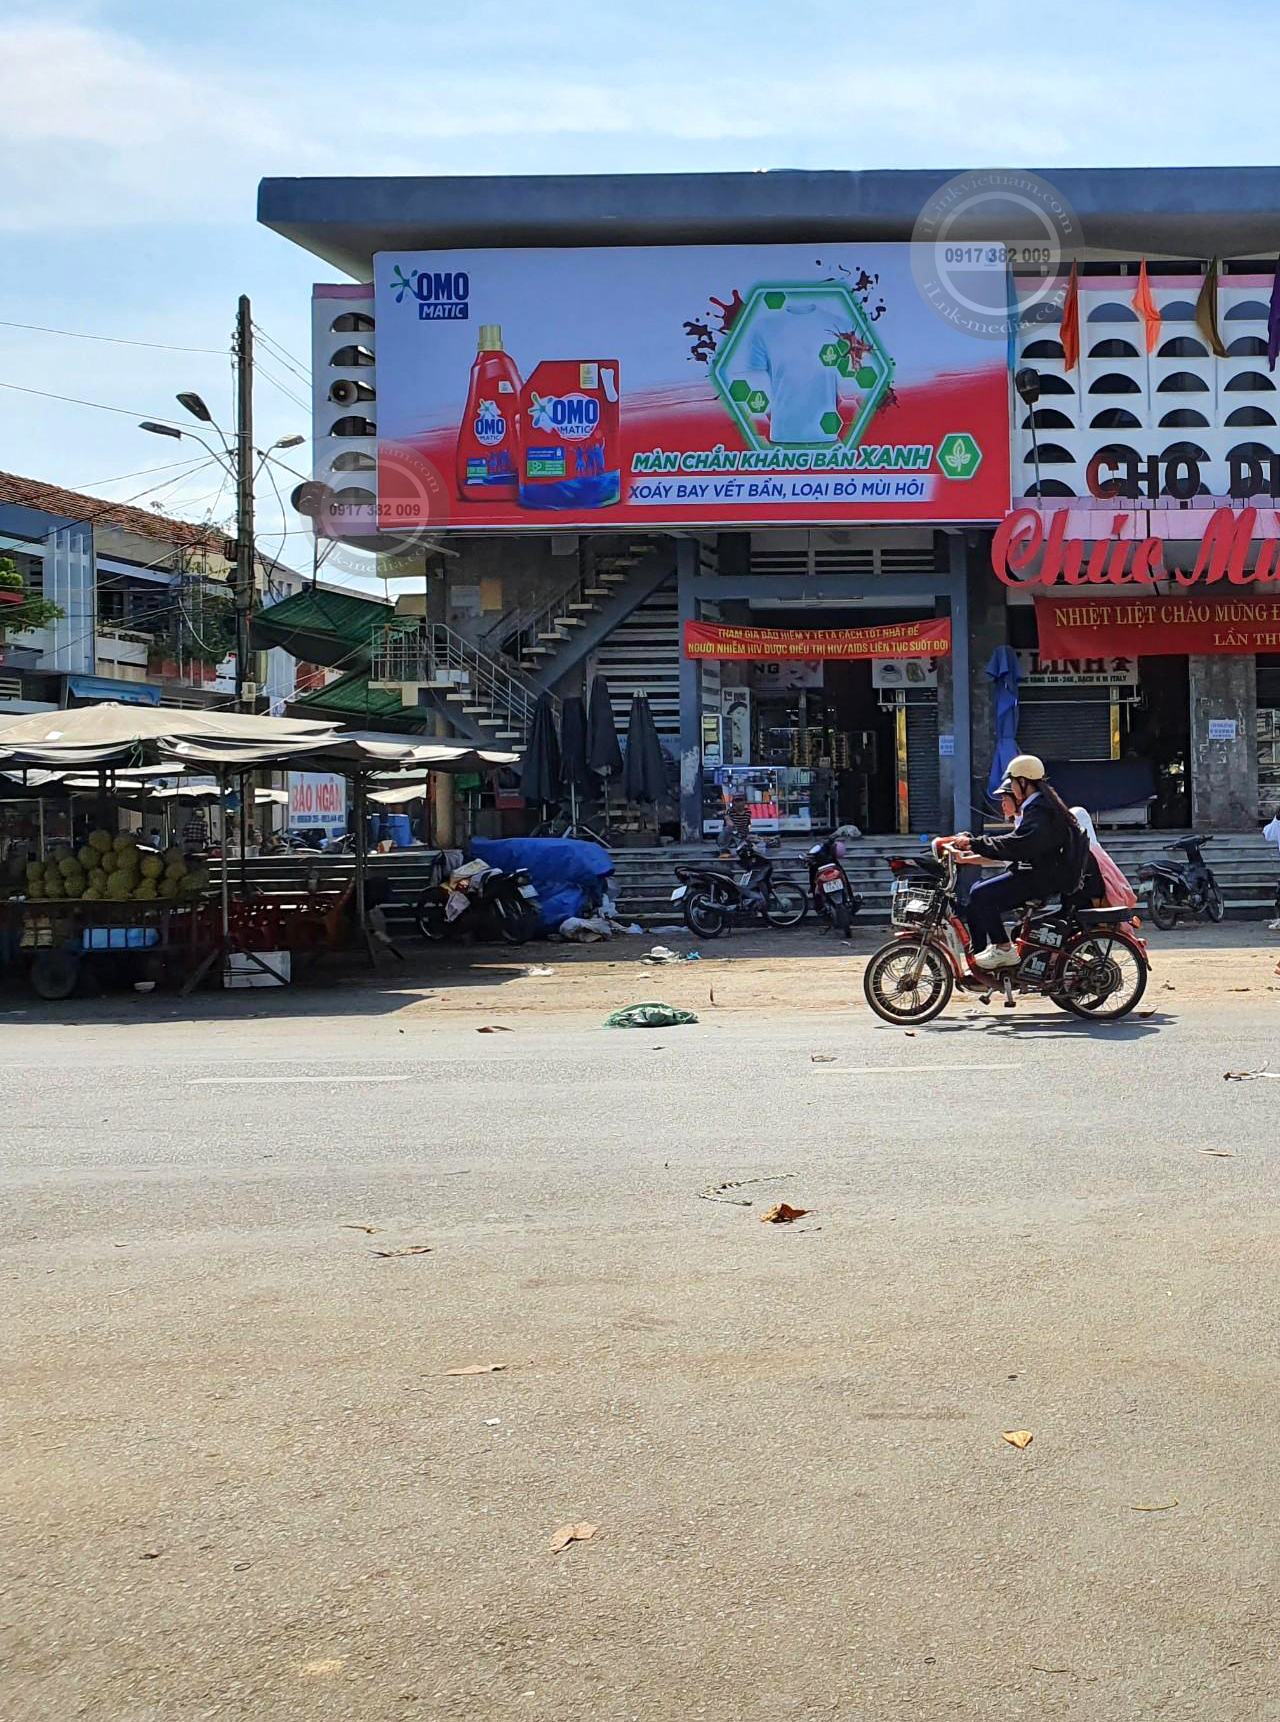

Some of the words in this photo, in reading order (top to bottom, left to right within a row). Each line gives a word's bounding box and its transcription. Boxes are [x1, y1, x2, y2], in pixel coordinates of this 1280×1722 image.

[417, 272, 469, 301] OMO
[422, 304, 465, 318] MATIC
[552, 400, 599, 425] OMO
[475, 418, 505, 435] OMO
[560, 426, 590, 435] MATIC
[633, 449, 681, 471] MÀN
[682, 445, 735, 471] CHẮN
[740, 449, 810, 470] KHÁNG
[814, 446, 857, 467] BẨN
[859, 446, 932, 468] XANH
[629, 481, 673, 499] XOÁY
[677, 483, 709, 498] BAY
[713, 479, 745, 497] VẾT
[749, 478, 787, 499] BẨN,
[791, 482, 829, 500] LOẠI
[833, 479, 857, 497] BỎ
[862, 480, 891, 496] MÙI
[895, 480, 924, 496] HÔI
[991, 507, 1168, 588] Chúc
[1053, 602, 1111, 630] NHIỆT
[1115, 601, 1156, 629] LIỆT
[1161, 600, 1209, 623] CHÀO
[1215, 600, 1267, 622] MỪNG
[744, 629, 759, 639] GIA
[1213, 629, 1249, 646] LẦN
[747, 643, 763, 654] HIV
[827, 643, 868, 654] HIV/AIDS
